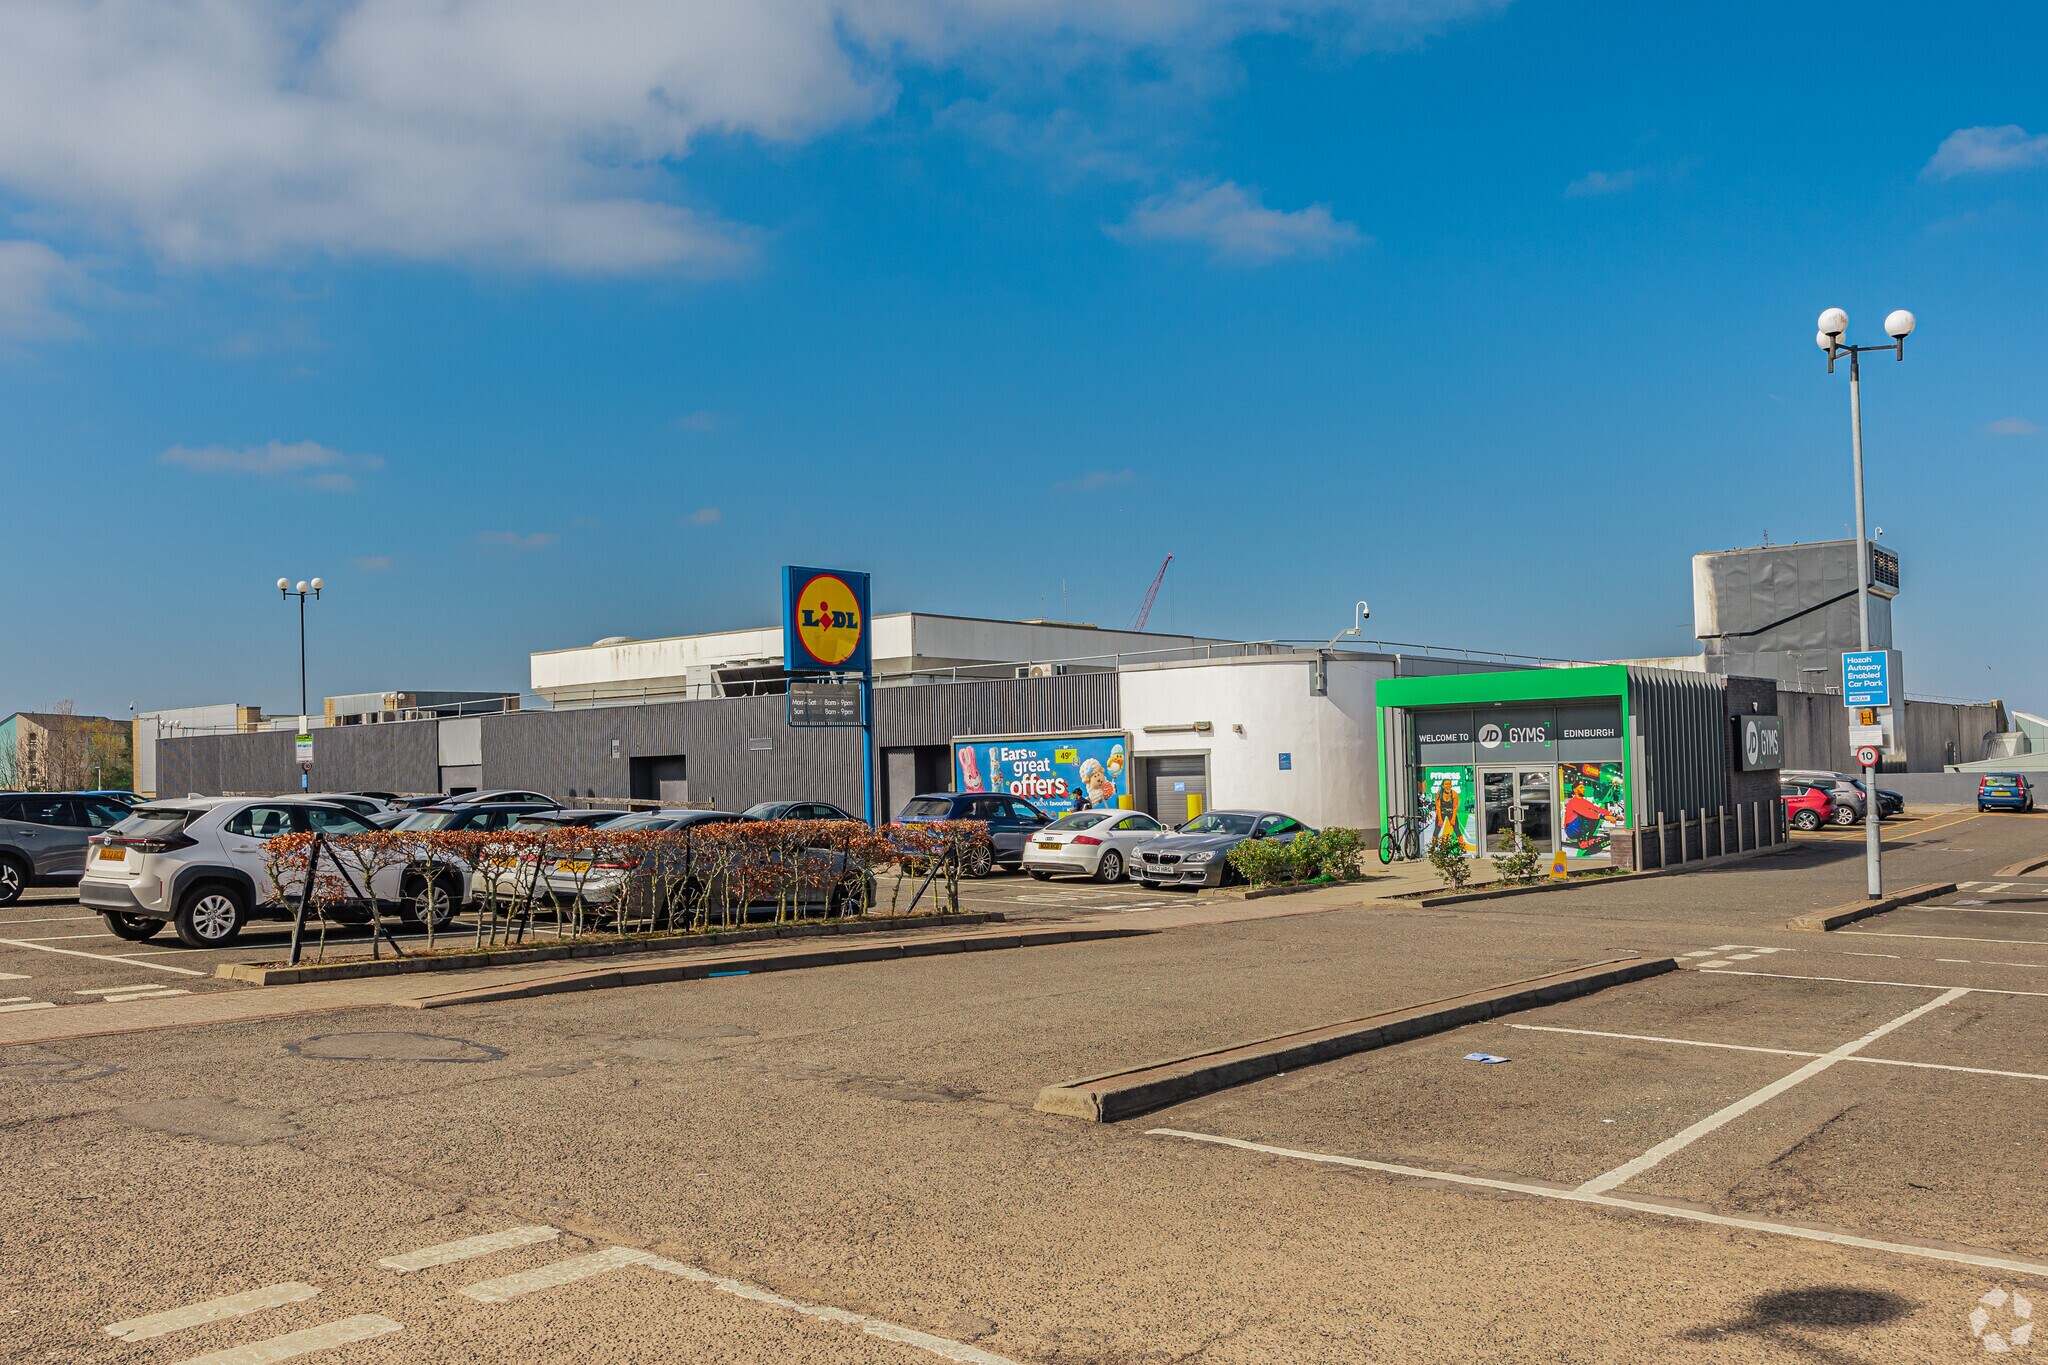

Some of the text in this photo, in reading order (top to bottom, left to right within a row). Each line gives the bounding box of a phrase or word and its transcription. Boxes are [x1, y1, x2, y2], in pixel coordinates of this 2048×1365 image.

[1847, 664, 1881, 672] Autopay
[840, 698, 854, 707] 9pm
[1419, 733, 1469, 742] WELCOME TO
[1482, 726, 1546, 744] JD GYMS
[1564, 728, 1614, 738] EDINBURGH
[1748, 729, 1779, 756] JD GYMS
[1001, 747, 1028, 762] Ears
[1862, 752, 1873, 760] 10
[1013, 758, 1050, 777] great
[1010, 773, 1067, 796] offers
